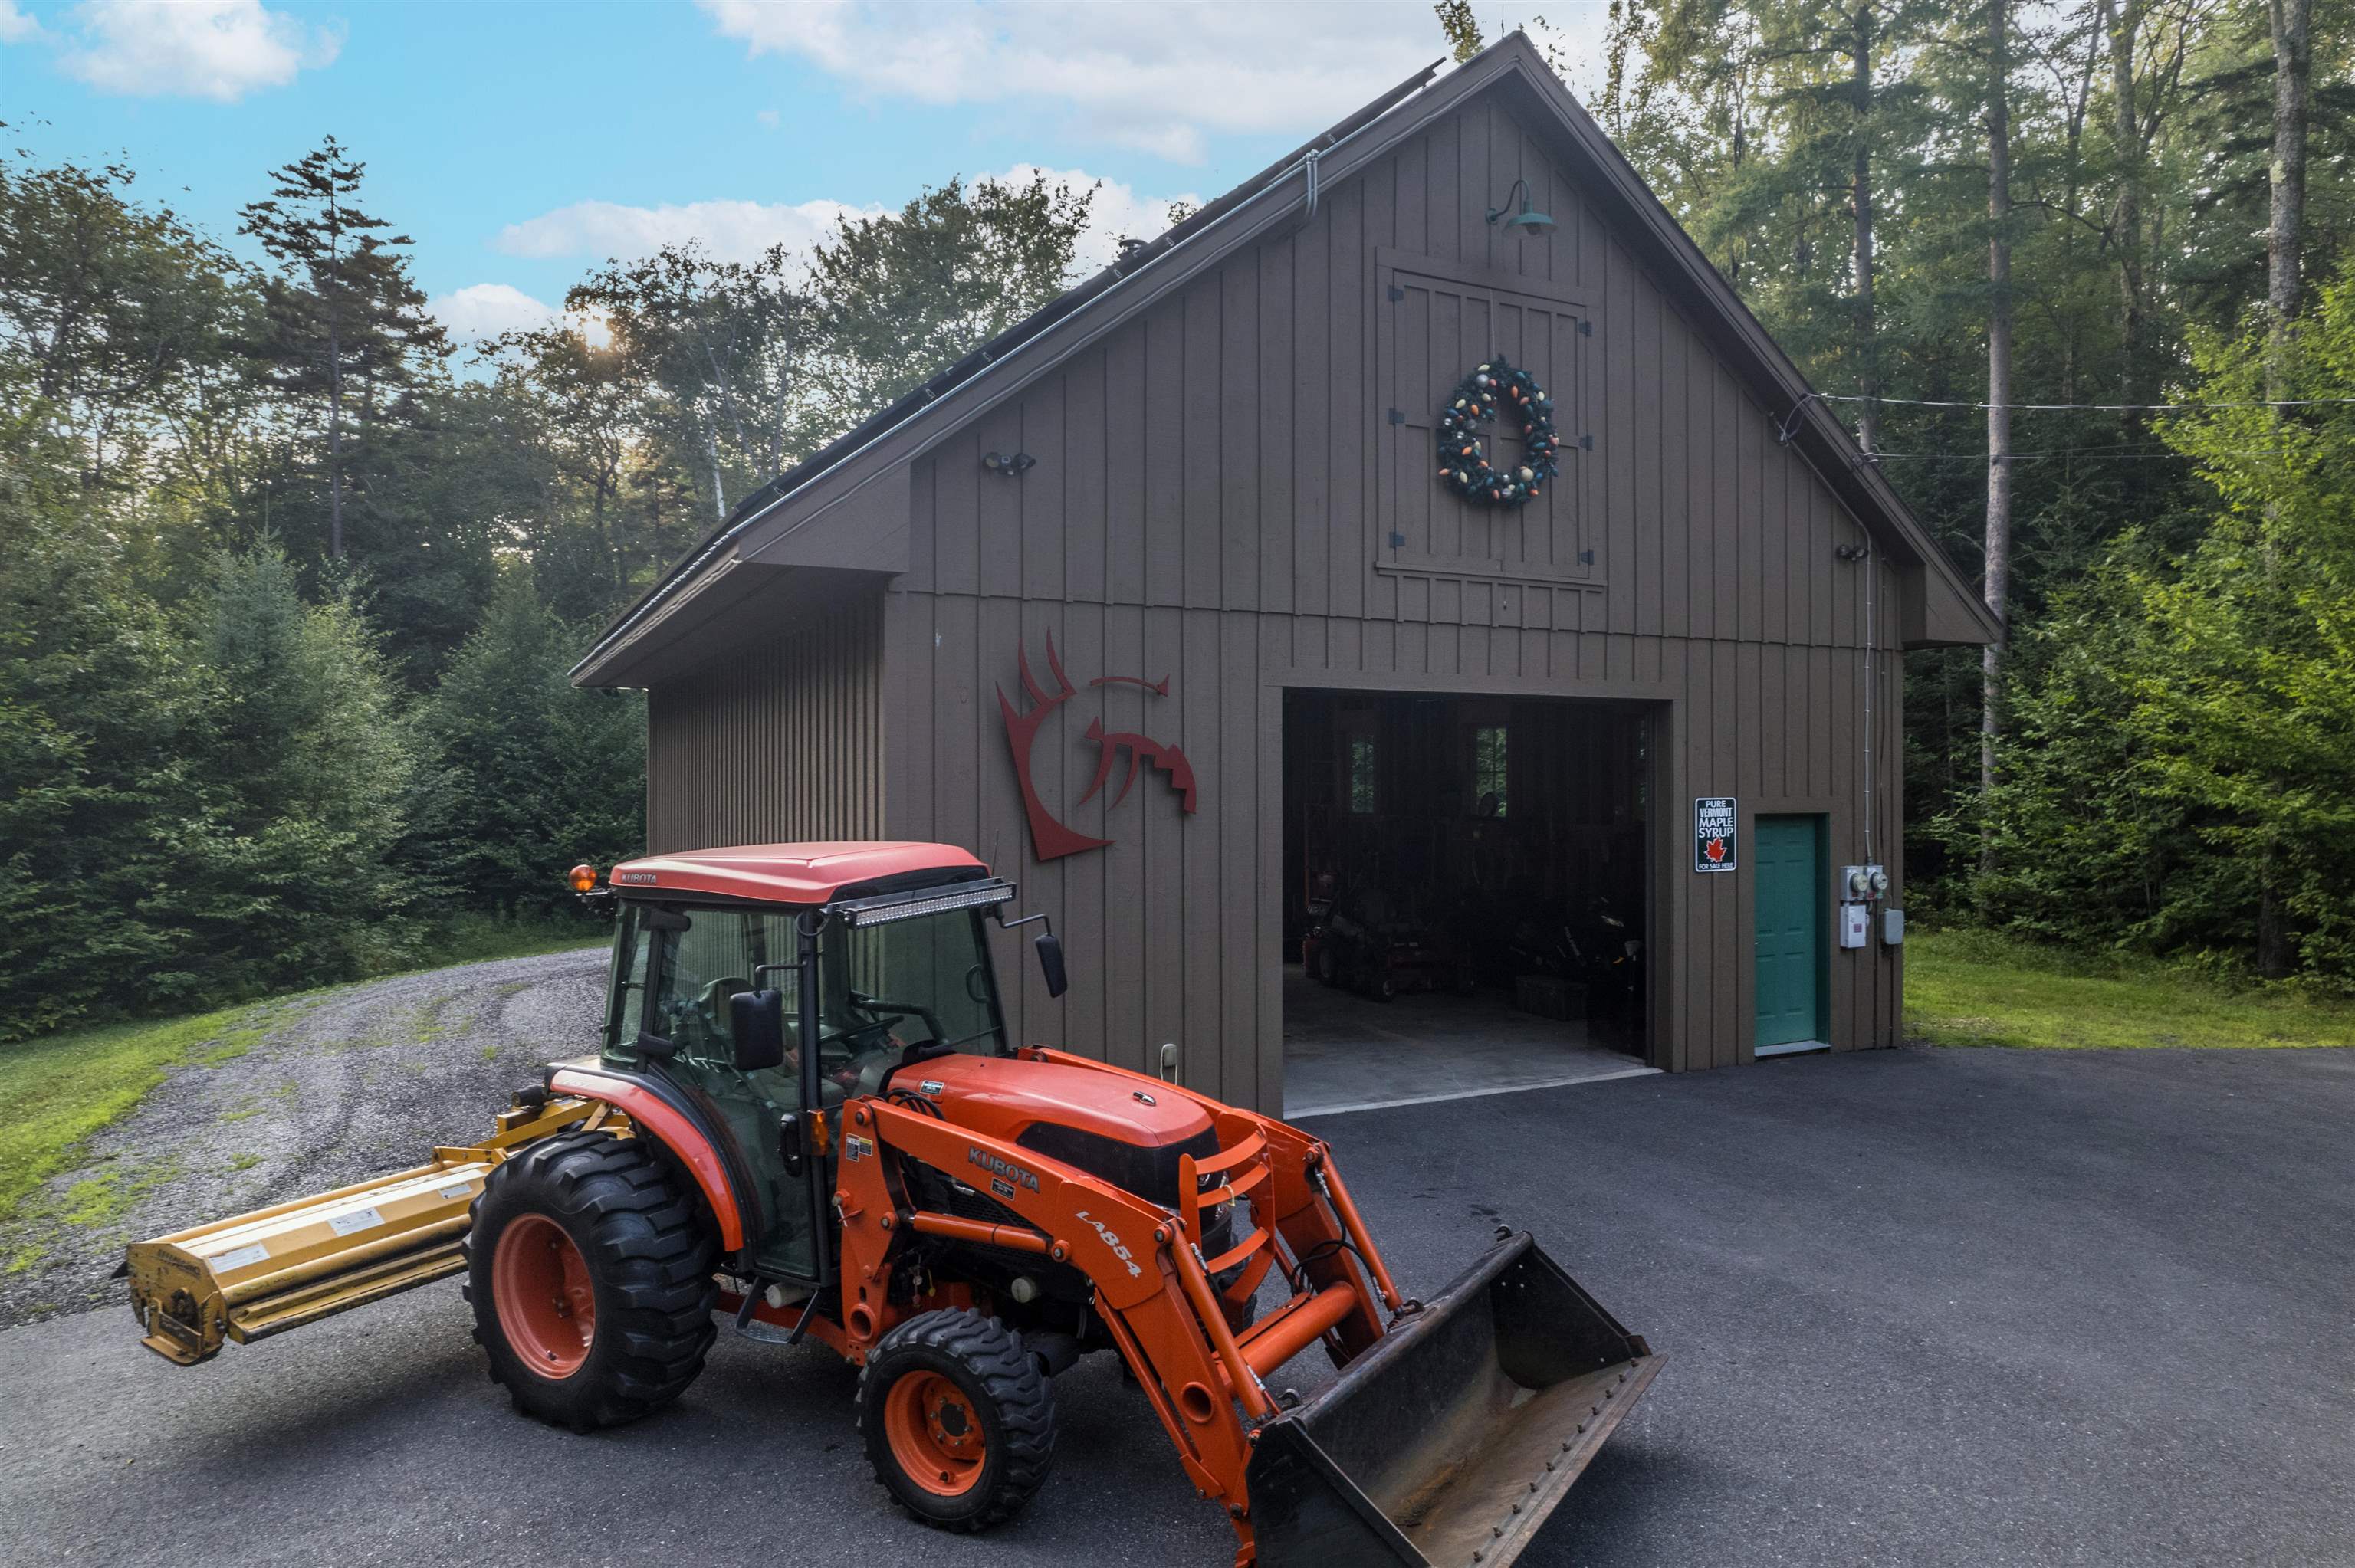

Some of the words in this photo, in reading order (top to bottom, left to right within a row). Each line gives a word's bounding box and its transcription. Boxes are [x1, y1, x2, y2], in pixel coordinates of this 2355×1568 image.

[1700, 808, 1733, 817] VERMONT
[1699, 818, 1733, 827] MAPLE
[1699, 828, 1733, 838] SYRUP
[622, 873, 657, 884] KUBOTA
[968, 1146, 1040, 1193] KUBOTA
[1075, 1210, 1142, 1278] LA854
